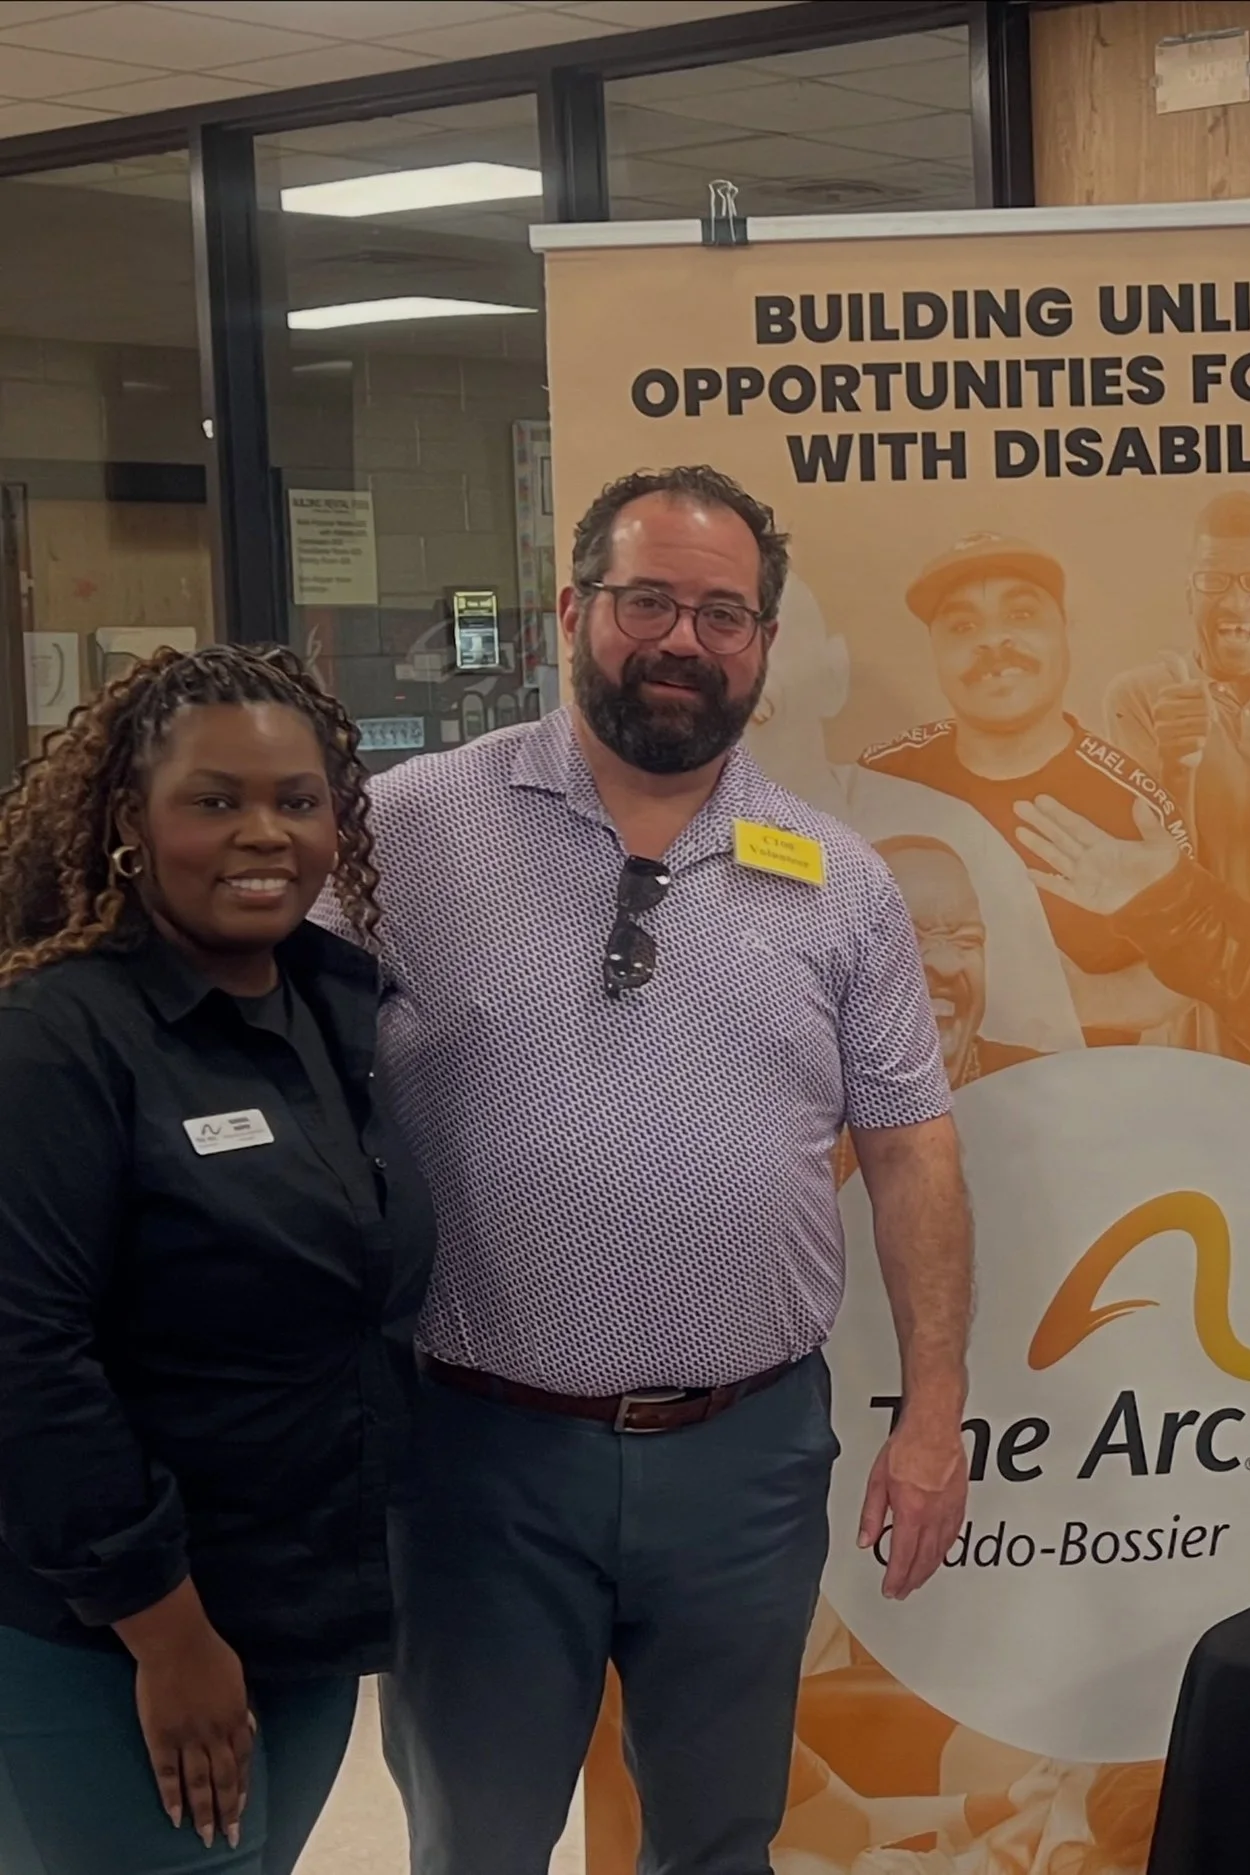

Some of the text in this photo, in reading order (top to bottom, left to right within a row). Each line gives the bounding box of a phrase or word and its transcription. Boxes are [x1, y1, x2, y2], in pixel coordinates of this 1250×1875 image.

[755, 287, 1073, 345] BUILDING
[632, 355, 1166, 418] OPPORTUNITIES
[786, 431, 967, 484] WITH
[1128, 768, 1175, 816] KORS
[873, 1514, 1231, 1569] Cddo-Bossier
